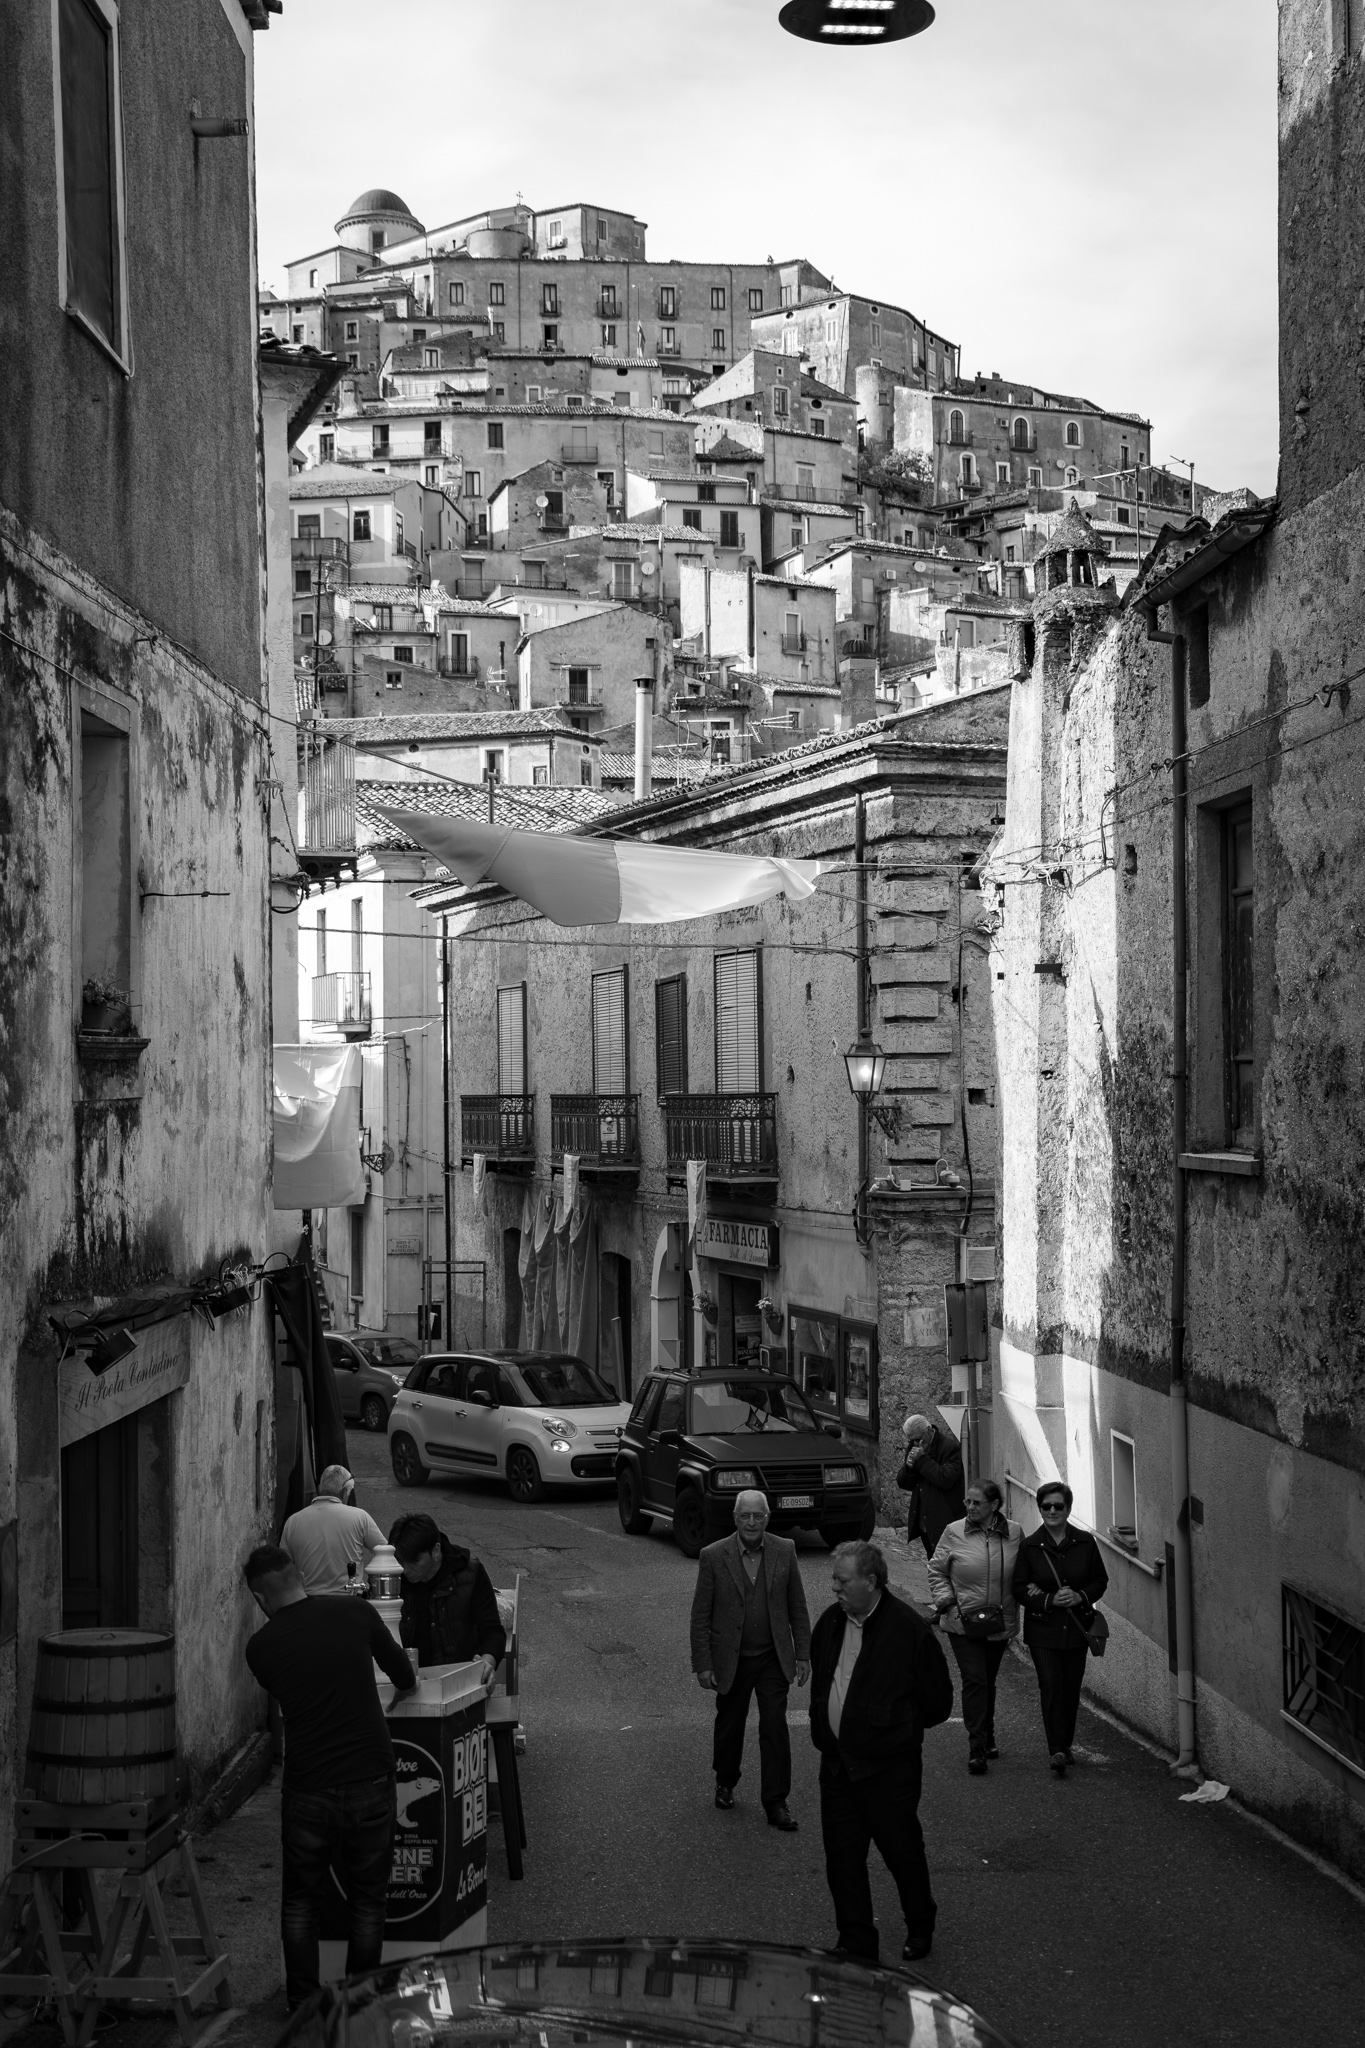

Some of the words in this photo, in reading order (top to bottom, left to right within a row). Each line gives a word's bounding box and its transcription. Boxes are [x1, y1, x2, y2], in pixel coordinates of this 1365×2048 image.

[709, 1221, 768, 1250] FARMACIA
[75, 1382, 92, 1412] Il
[94, 1371, 125, 1404] Poeta
[129, 1350, 179, 1387] Contadino
[396, 1757, 419, 1772] boe
[462, 1778, 487, 1847] BE
[393, 1847, 433, 1866] RNE
[390, 1865, 424, 1885] ER
[391, 1889, 427, 1899] dell'Orso
